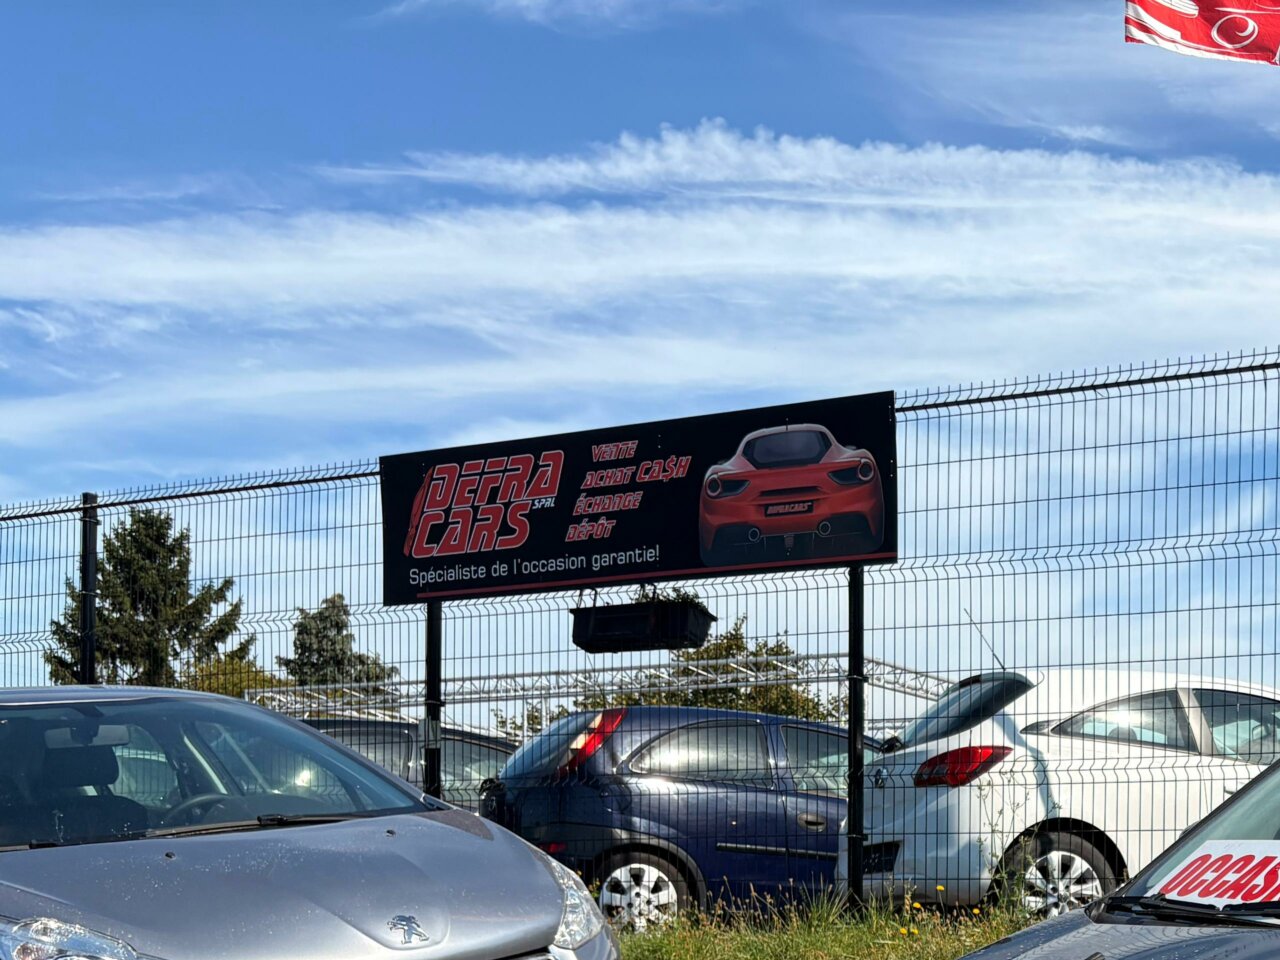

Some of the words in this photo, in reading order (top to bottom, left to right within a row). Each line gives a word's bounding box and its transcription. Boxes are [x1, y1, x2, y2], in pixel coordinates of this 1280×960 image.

[591, 440, 639, 462] VENTE
[424, 449, 564, 512] DEFRA
[580, 466, 636, 489] ACHAT
[532, 498, 555, 510] SPRL
[572, 491, 643, 516] ÉCHANGE
[411, 500, 532, 559] CARS
[565, 516, 616, 542] DÉPÔT
[409, 563, 487, 587] Spécialiste
[491, 561, 508, 577] de
[513, 553, 587, 575] l'occasion
[592, 544, 660, 571] garantie!
